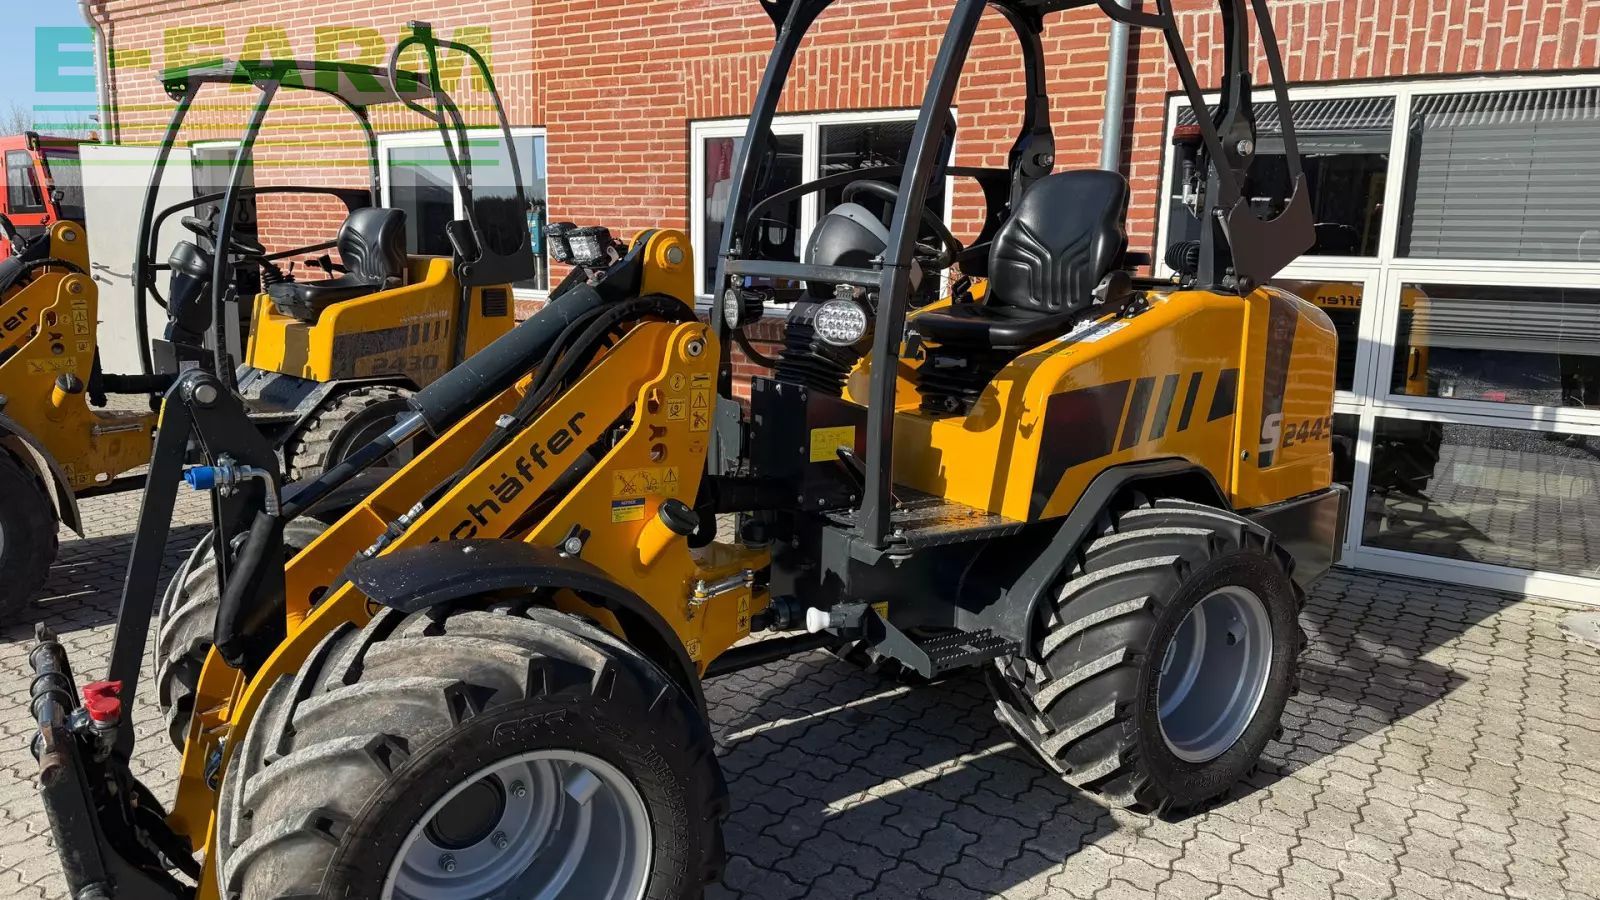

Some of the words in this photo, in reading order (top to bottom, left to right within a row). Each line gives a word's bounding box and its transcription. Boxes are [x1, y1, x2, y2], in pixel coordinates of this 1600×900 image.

[372, 354, 439, 373] 2430
[1283, 416, 1331, 448] 2445
[430, 411, 586, 543] chäffer
